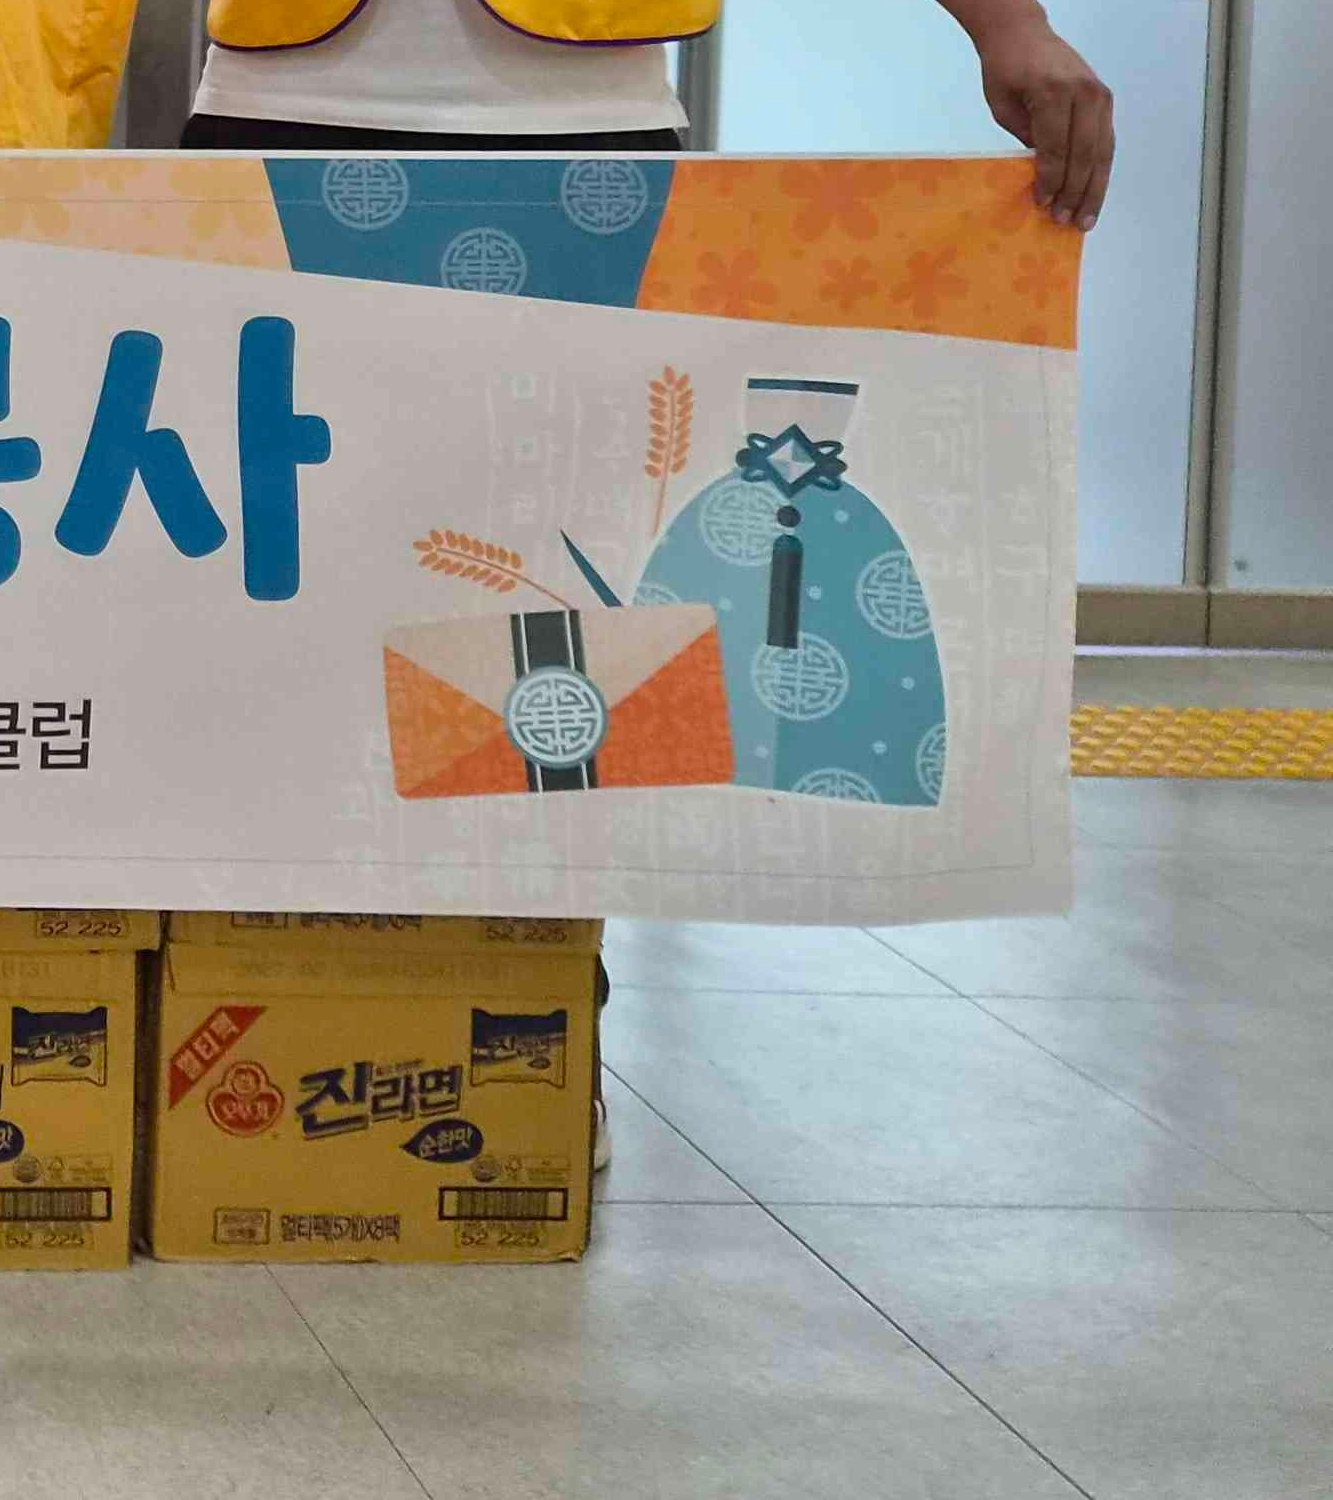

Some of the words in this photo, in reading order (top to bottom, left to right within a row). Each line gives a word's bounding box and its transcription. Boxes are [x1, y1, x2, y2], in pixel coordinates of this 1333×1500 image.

[40, 921, 68, 936] 52
[78, 921, 123, 936] 225
[295, 1061, 463, 1141] 진라면
